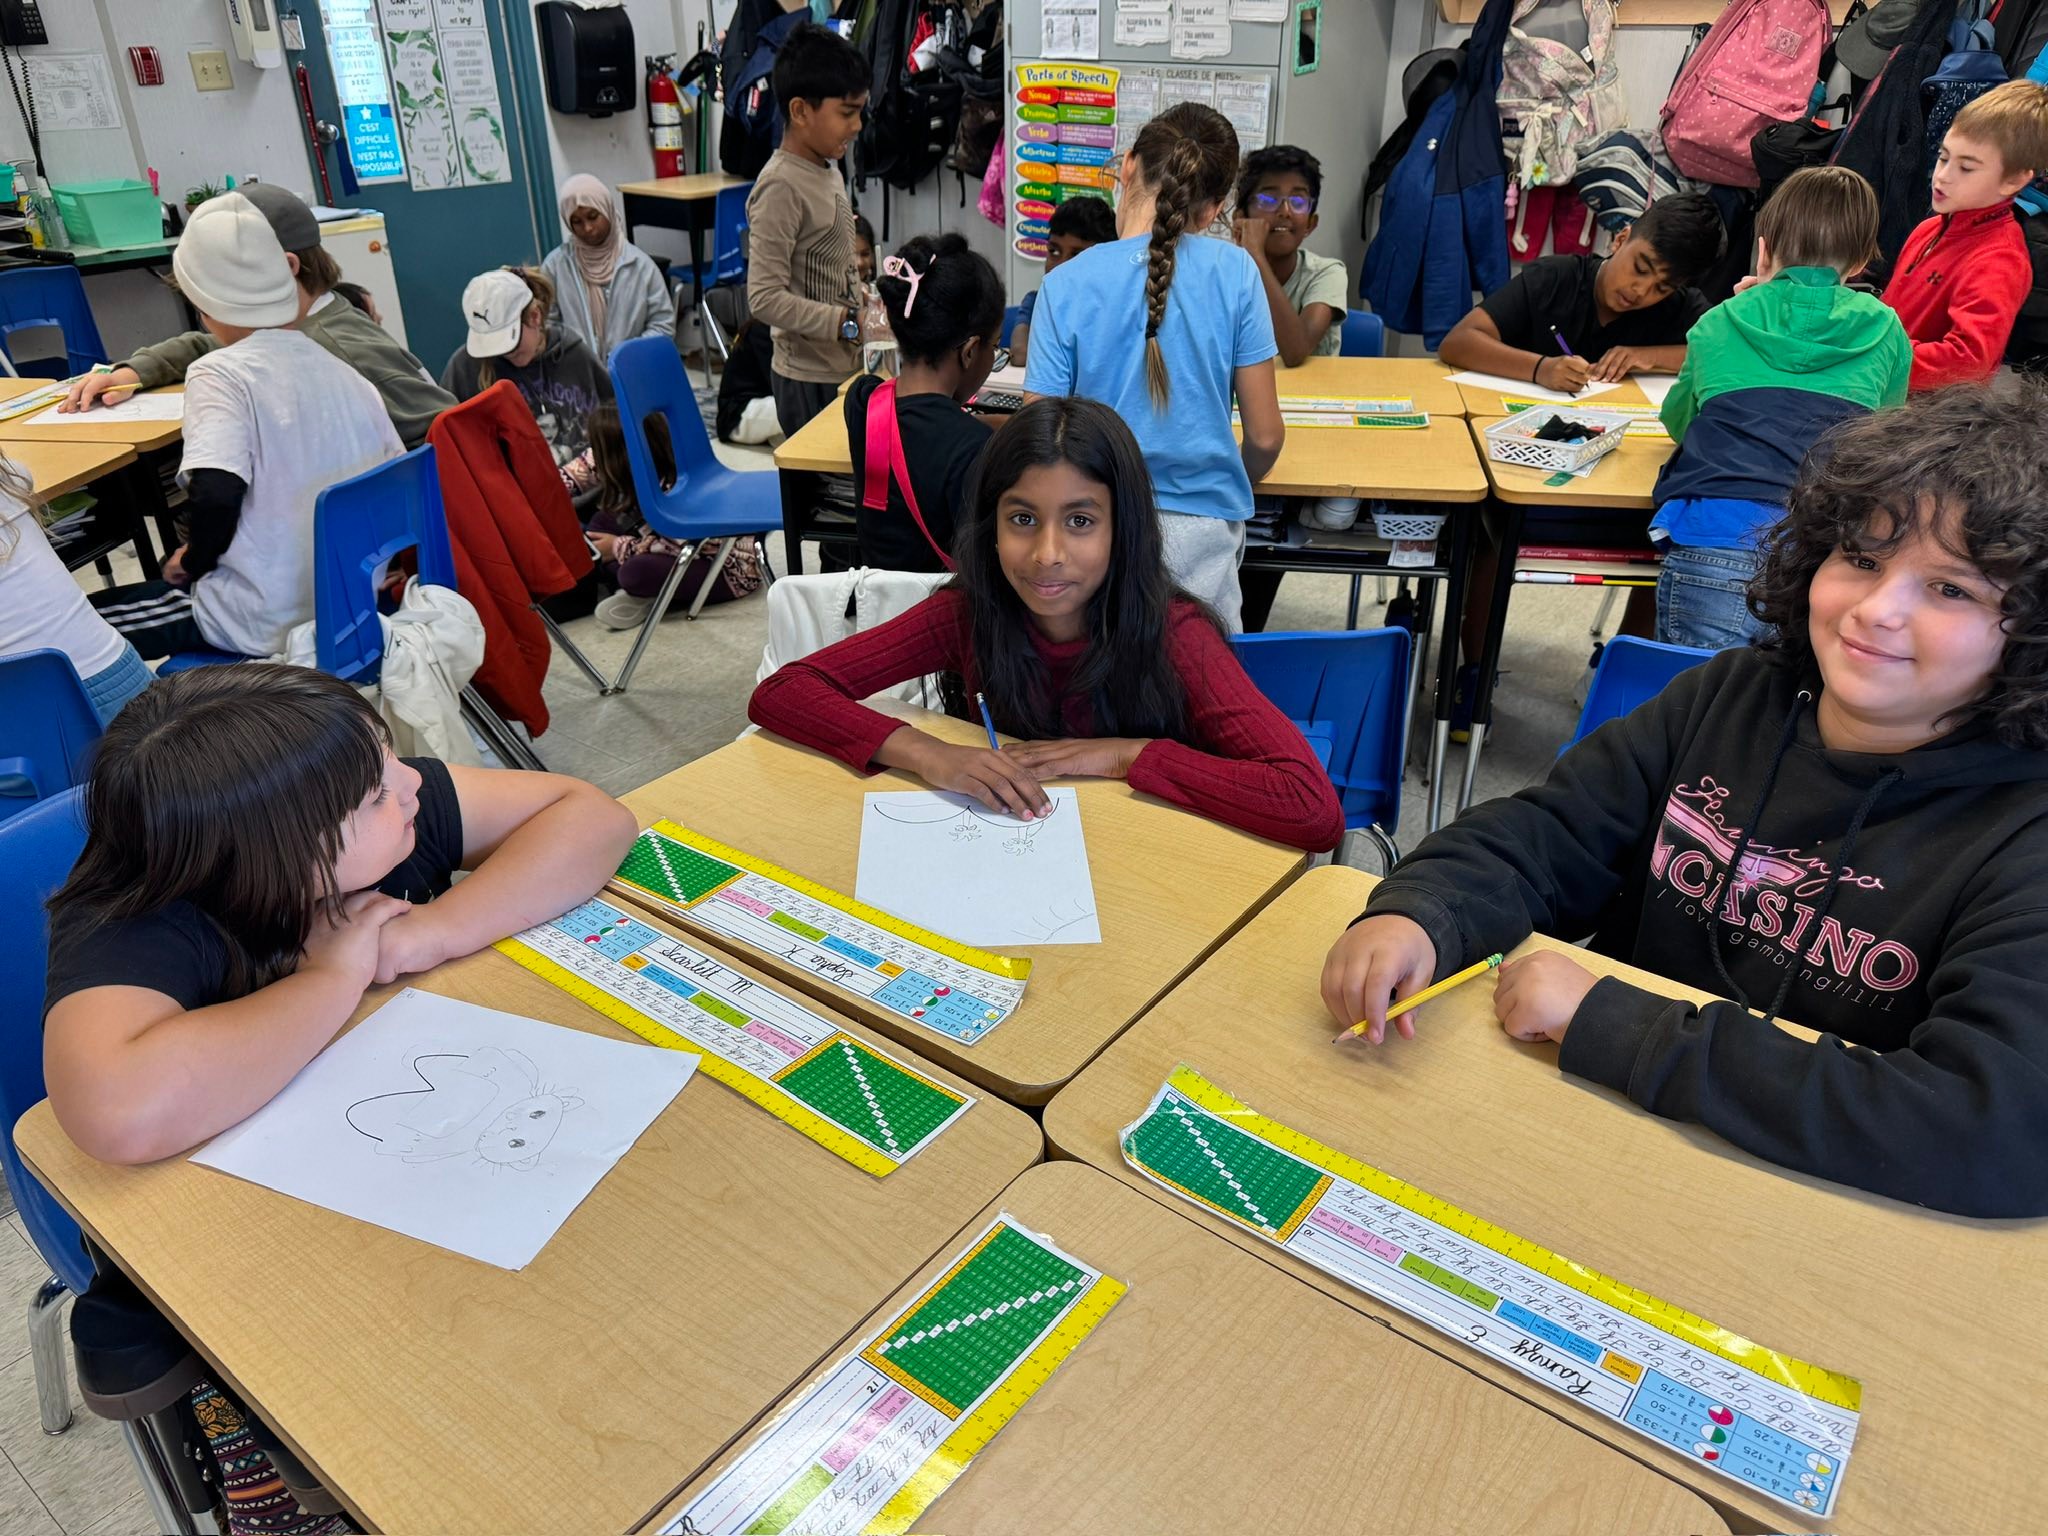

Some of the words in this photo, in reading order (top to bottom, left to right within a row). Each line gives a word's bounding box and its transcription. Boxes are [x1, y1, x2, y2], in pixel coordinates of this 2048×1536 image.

[1026, 68, 1054, 81] Parts
[1057, 70, 1067, 79] of
[1071, 69, 1108, 86] Speech
[1167, 69, 1198, 79] CLASSES
[1201, 71, 1211, 79] DE
[359, 123, 379, 133] C'EST
[354, 134, 391, 145] DIFFICILE
[357, 152, 377, 162] N'EST
[379, 150, 394, 160] PAS
[1656, 888, 1667, 900] I
[1675, 897, 1711, 930] love
[660, 938, 719, 979] Scarlett
[783, 943, 804, 959] K
[810, 955, 853, 985] Sophia
[1511, 1333, 1590, 1399] Ramzy
[866, 1381, 878, 1393] 21
